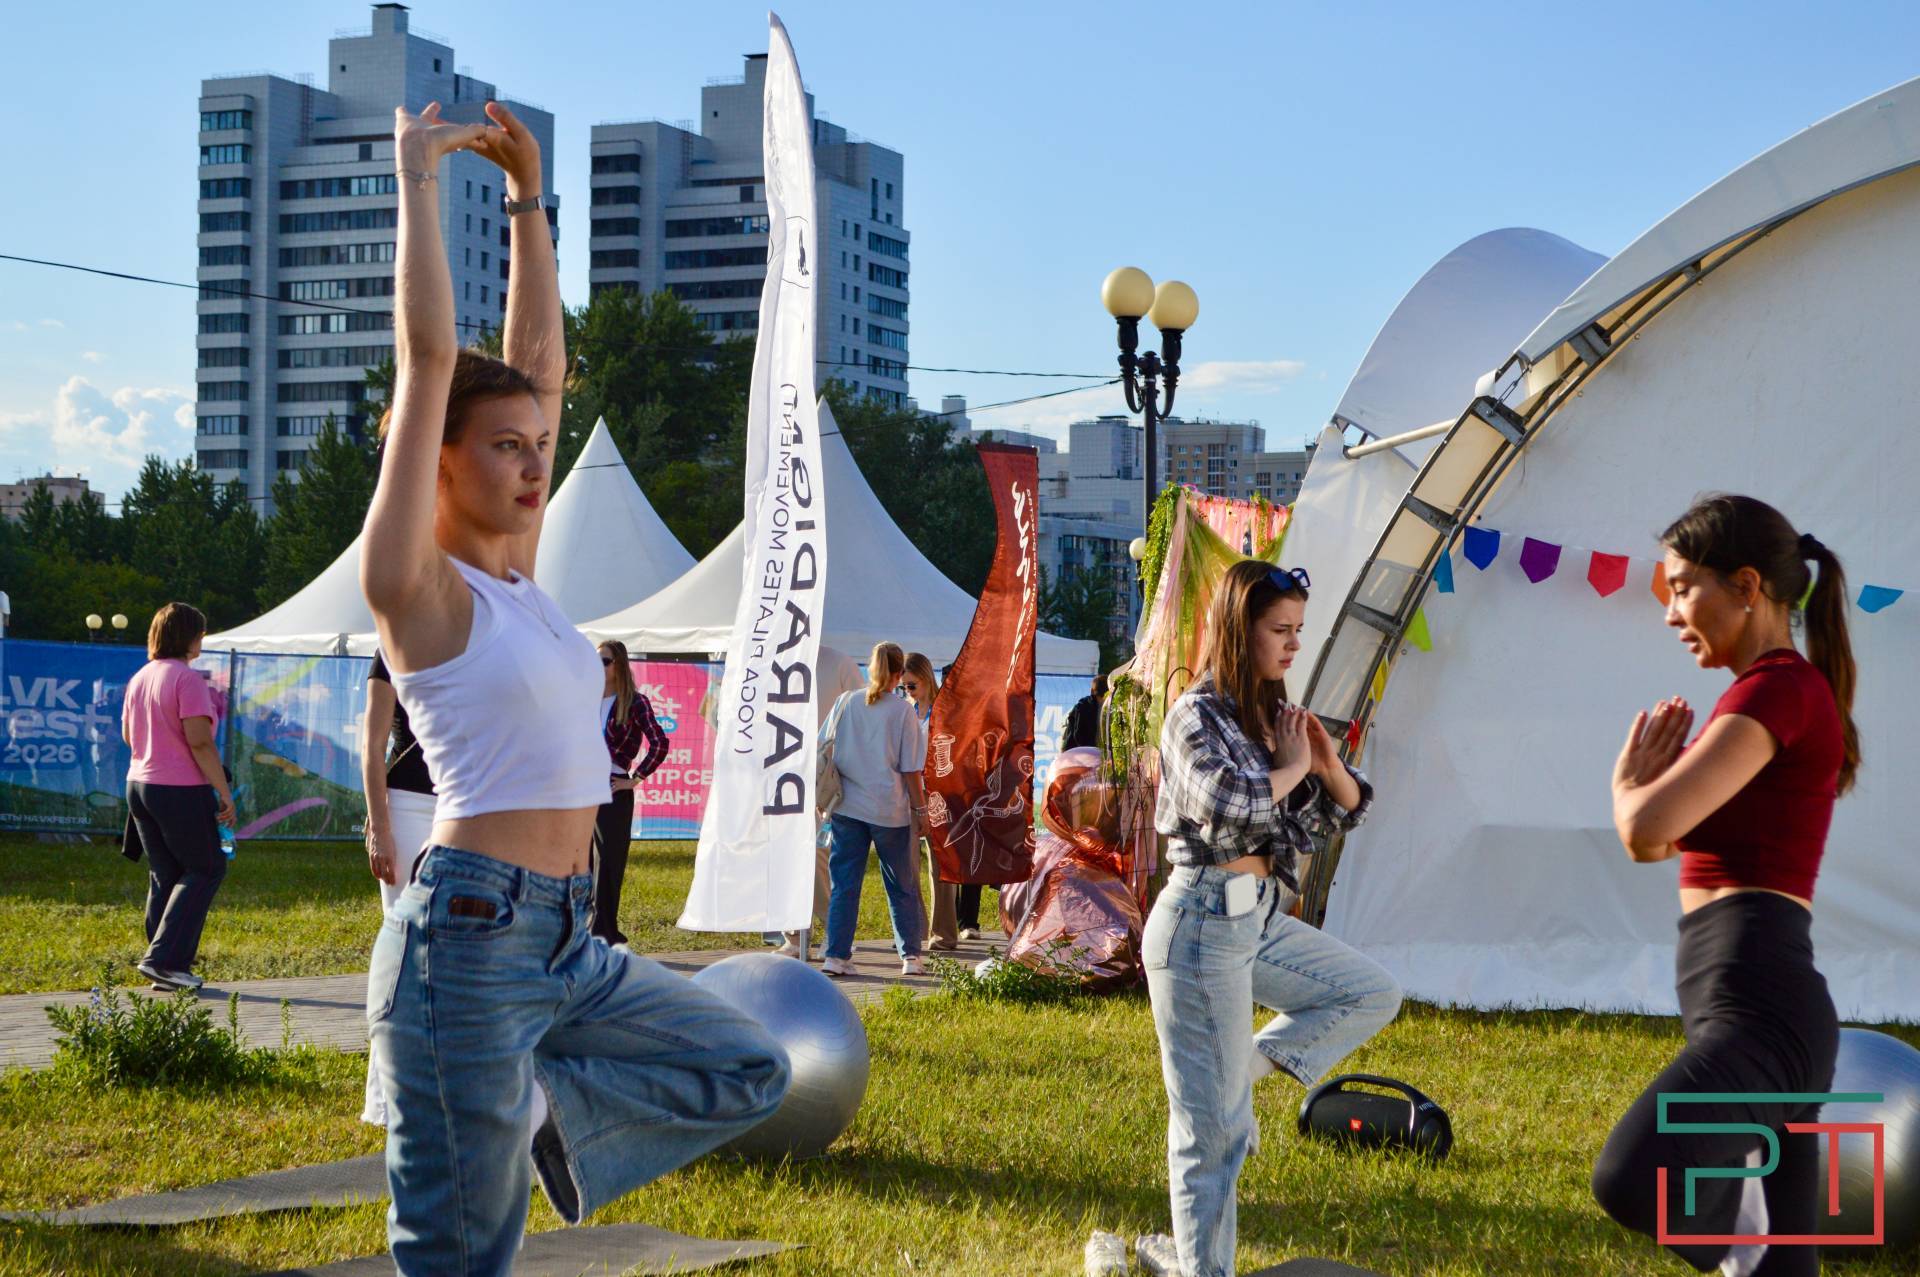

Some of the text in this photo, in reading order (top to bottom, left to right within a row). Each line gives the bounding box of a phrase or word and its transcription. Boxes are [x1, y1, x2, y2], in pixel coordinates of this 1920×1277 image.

[8, 675, 82, 709] VK
[0, 695, 113, 743] est
[3, 743, 77, 764] 2026
[683, 769, 714, 786] СЕ
[636, 789, 702, 806] АЗАН»
